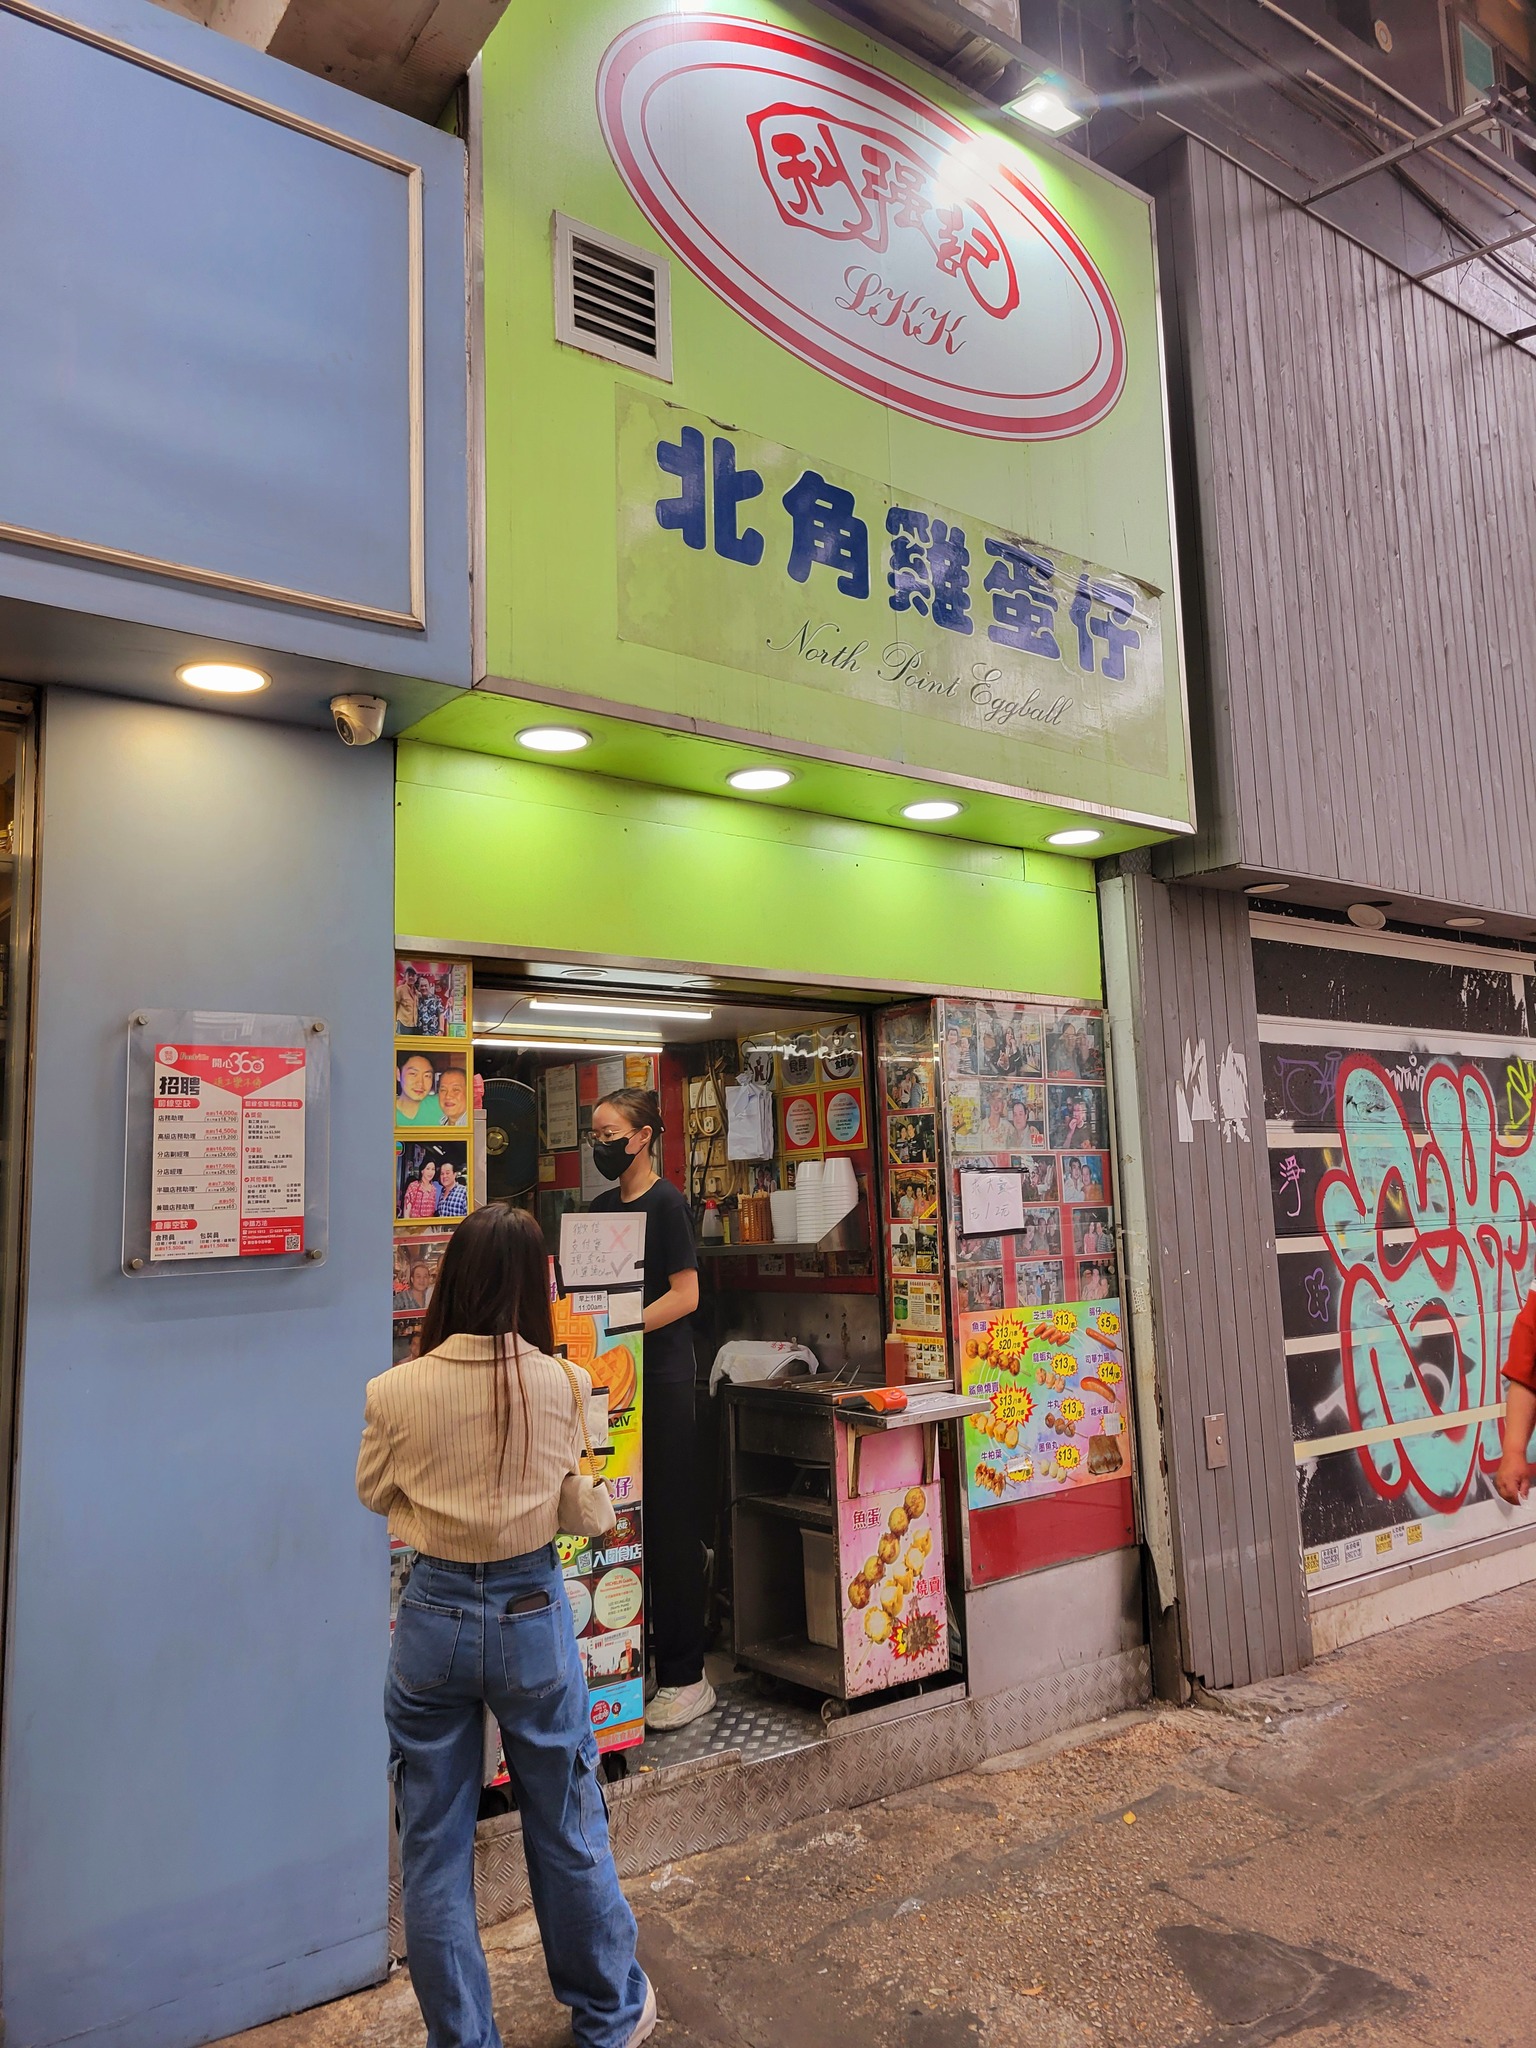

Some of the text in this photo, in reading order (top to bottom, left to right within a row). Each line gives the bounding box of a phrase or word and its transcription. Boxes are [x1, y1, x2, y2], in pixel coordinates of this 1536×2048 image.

[835, 265, 967, 355] LKK
[655, 425, 1141, 682] 北角雞蛋仔
[766, 619, 1073, 727] North Point Eggball
[159, 1076, 200, 1096] 招聘
[972, 1321, 987, 1331] 魚蛋
[1048, 1401, 1060, 1409] 牛丸
[853, 1508, 881, 1530] 魚蛋
[916, 1576, 942, 1597] 燒賣
